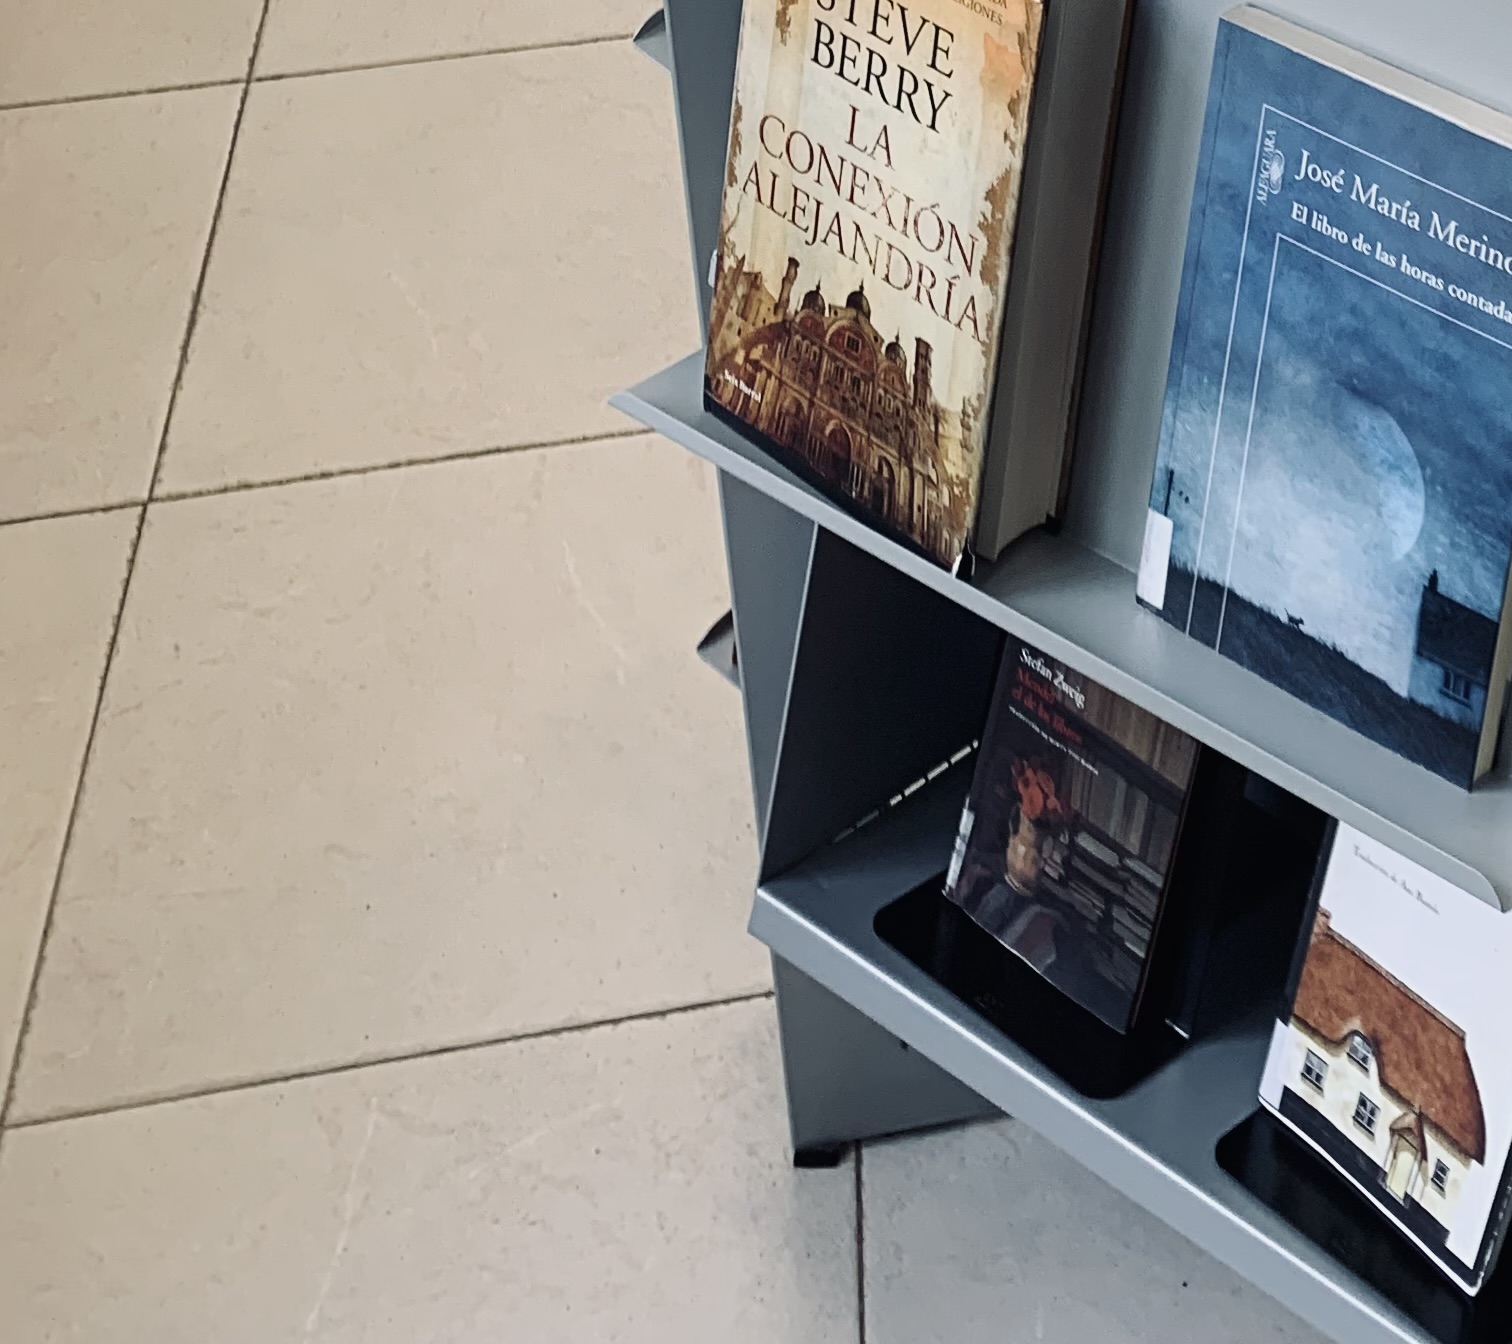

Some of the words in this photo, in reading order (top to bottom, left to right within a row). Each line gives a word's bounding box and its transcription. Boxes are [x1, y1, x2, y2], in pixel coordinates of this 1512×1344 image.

[810, 18, 954, 134] BERRY
[845, 104, 896, 173] LA
[1256, 129, 1277, 206] ALFAGUARA
[758, 113, 979, 279] CONEXIÓN
[1295, 148, 1345, 193] José
[1350, 174, 1421, 231] María
[742, 160, 986, 344] ALEJANDRÍA
[1291, 201, 1307, 225] El
[1311, 210, 1349, 244] libro
[1351, 233, 1372, 256] de
[1375, 242, 1397, 269] las
[1400, 253, 1444, 291] horas
[1020, 647, 1053, 682] Stefan
[1053, 668, 1086, 710] Zweig
